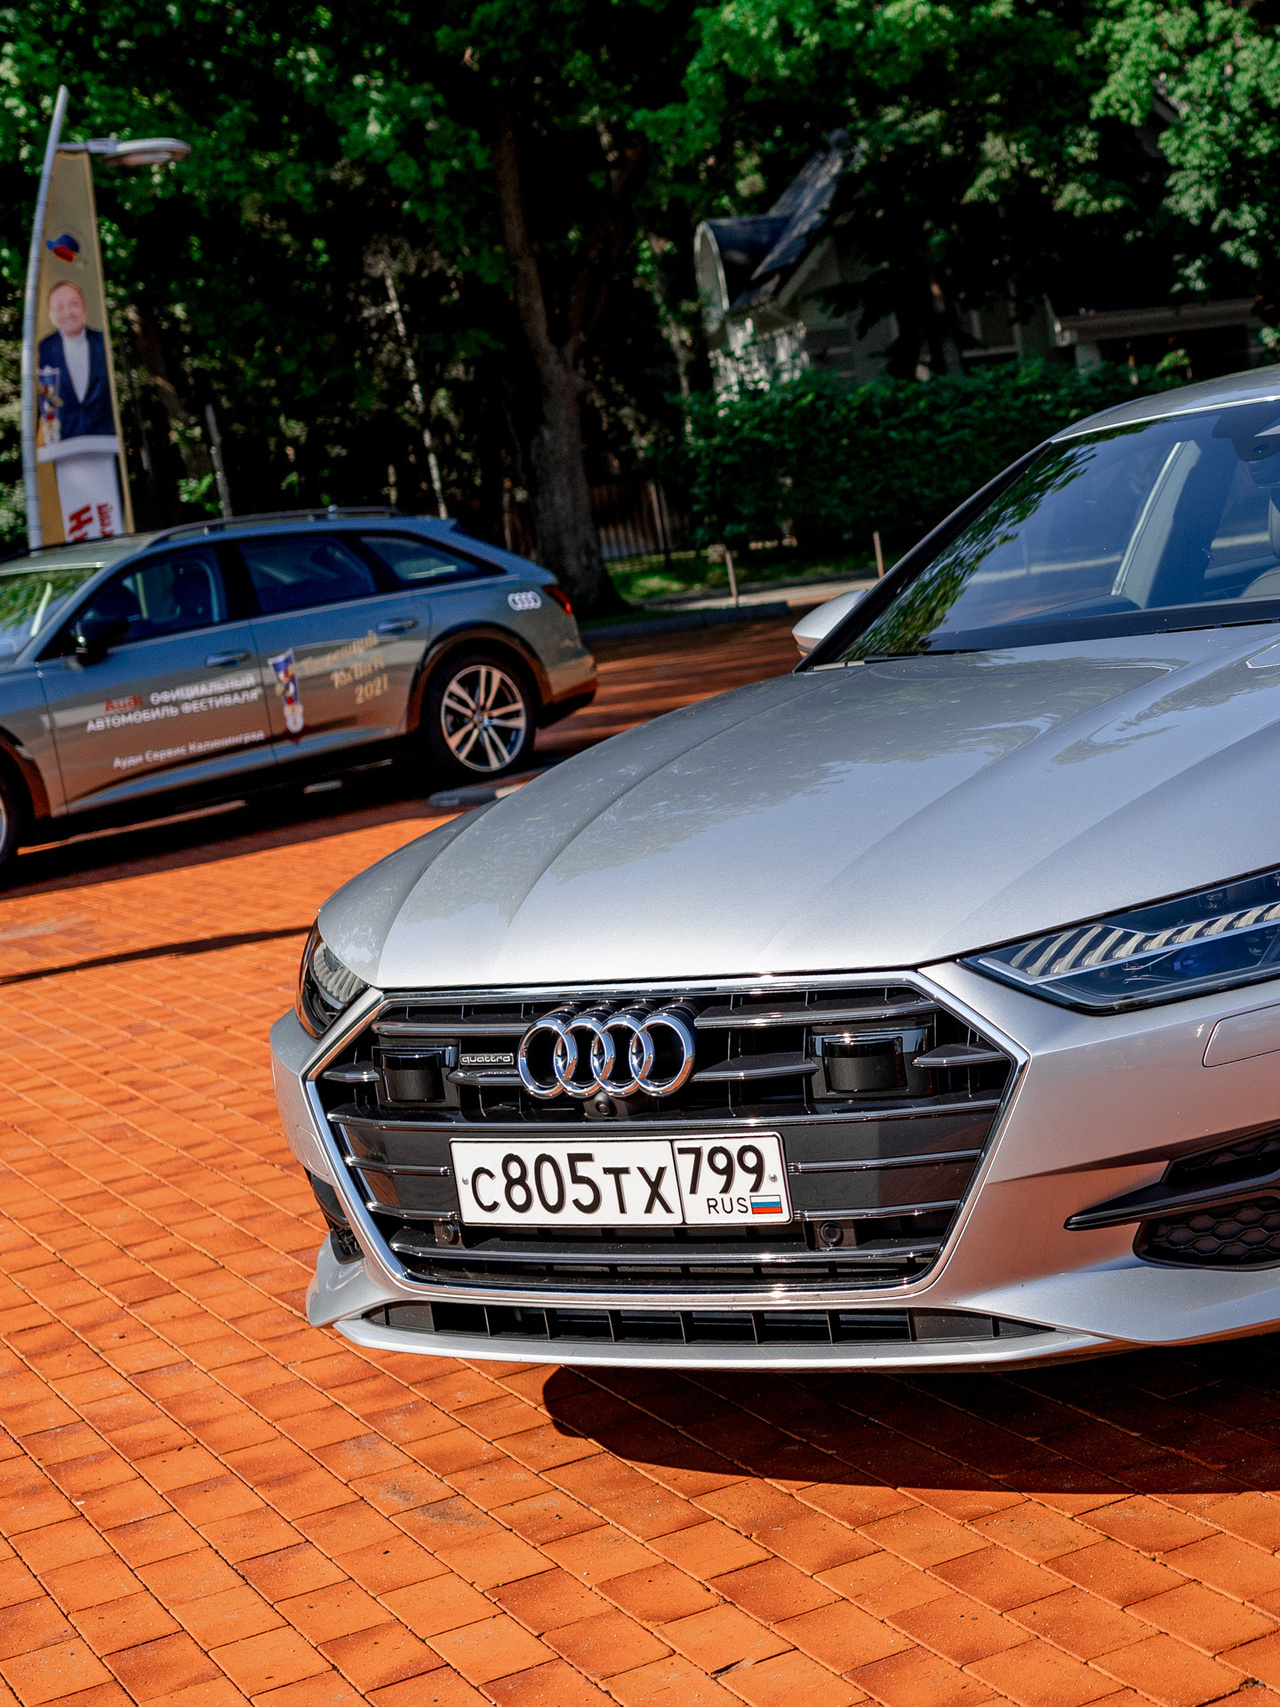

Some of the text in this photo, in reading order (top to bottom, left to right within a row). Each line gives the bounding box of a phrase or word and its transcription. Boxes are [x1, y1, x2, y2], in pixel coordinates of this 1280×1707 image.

[105, 675, 256, 714] Audi ОФИЦИАЛЬНЫЙ
[354, 673, 389, 705] 2021
[86, 690, 259, 733] АВТОМОБИЛЬ ФЕСТИВАЛЯ
[461, 1055, 511, 1064] quattro
[677, 1144, 766, 1195] 799
[707, 1197, 749, 1215] RUS
